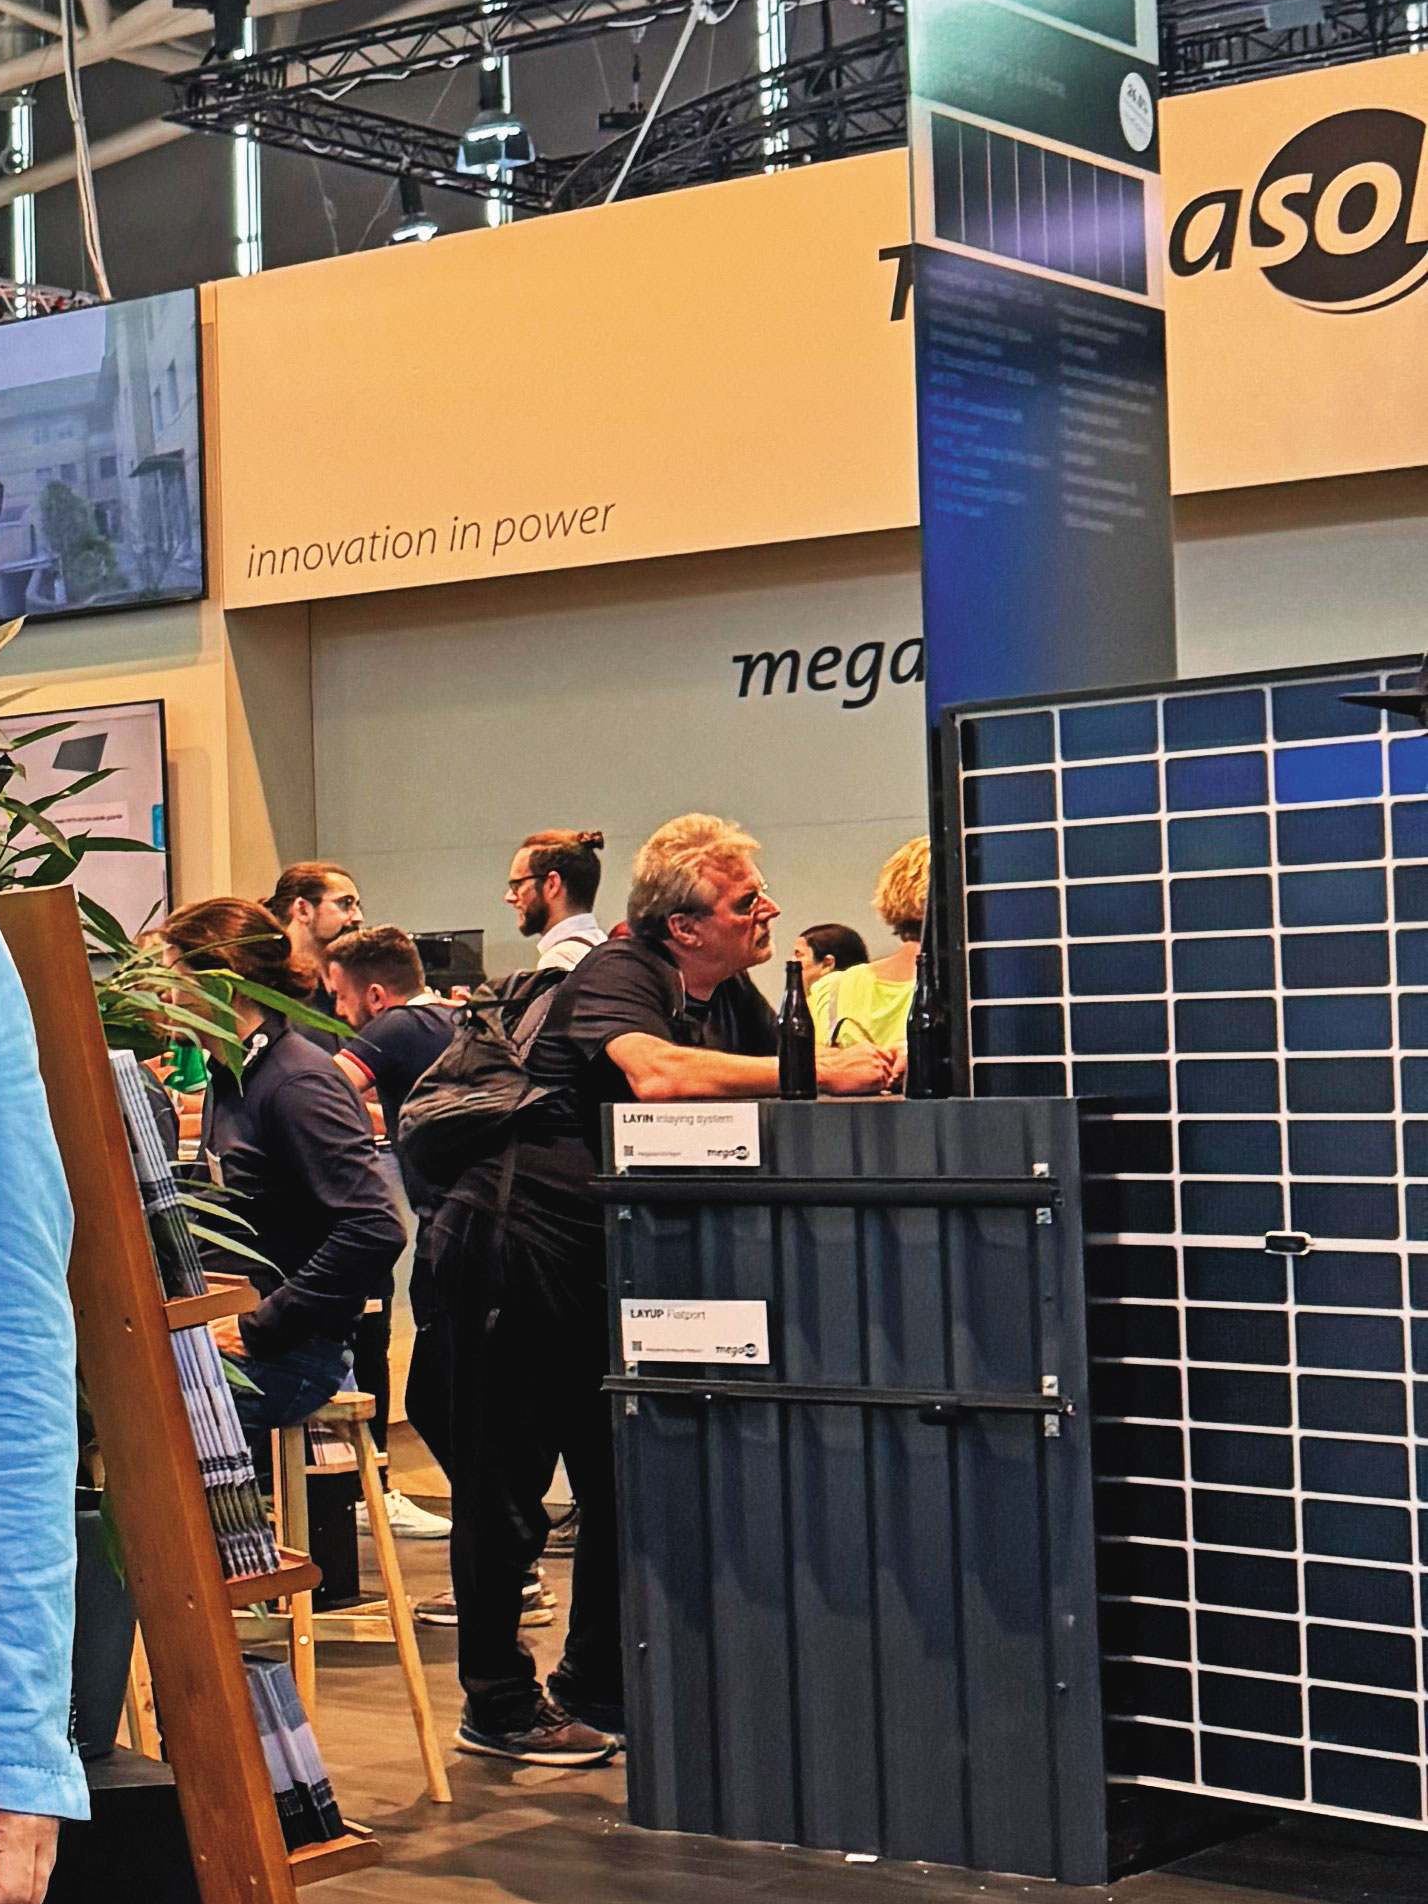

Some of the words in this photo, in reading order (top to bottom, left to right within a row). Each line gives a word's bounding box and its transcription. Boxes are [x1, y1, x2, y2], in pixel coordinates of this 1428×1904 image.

[246, 524, 438, 580] innovation
[449, 515, 481, 553] in
[491, 501, 617, 557] power
